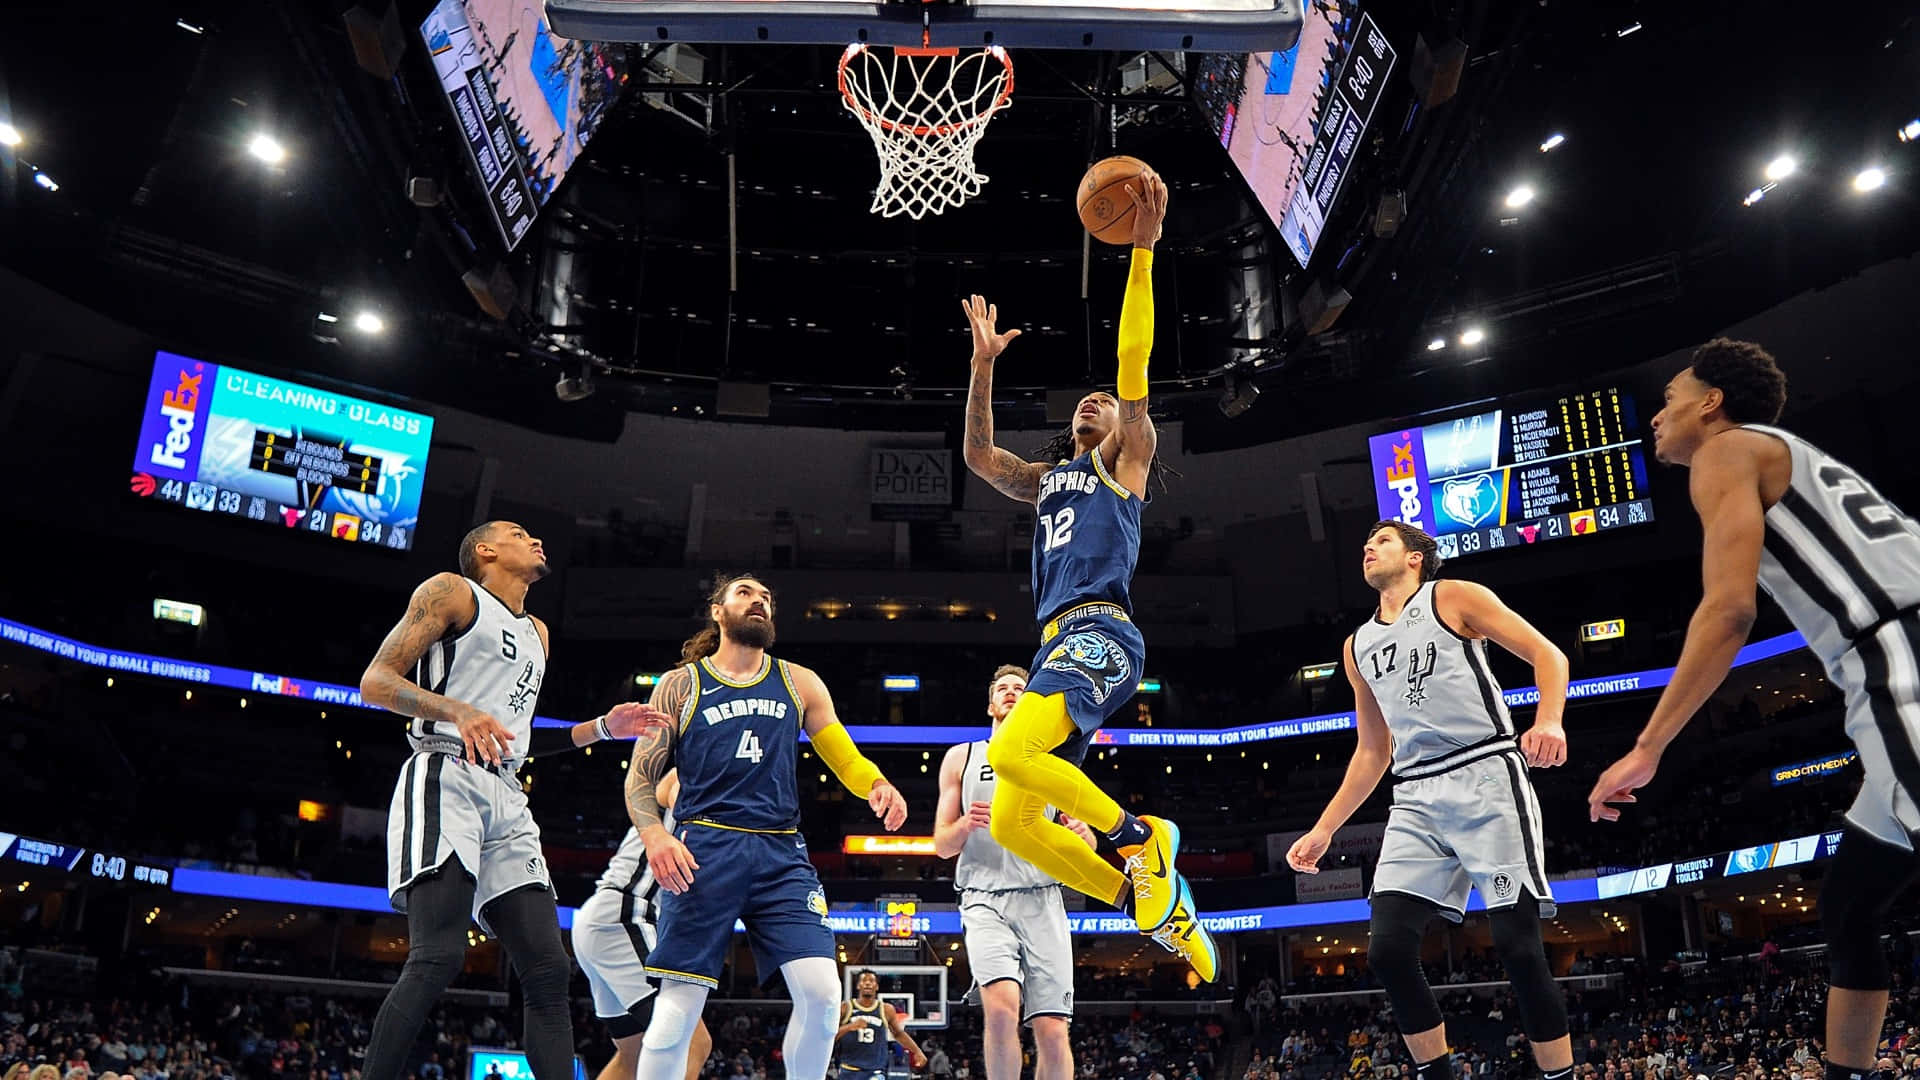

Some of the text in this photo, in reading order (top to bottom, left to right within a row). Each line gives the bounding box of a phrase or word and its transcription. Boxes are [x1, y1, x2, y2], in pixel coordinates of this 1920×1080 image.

[1349, 56, 1373, 100] 8:40
[500, 179, 523, 217] 8:40
[226, 375, 337, 415] CLEANING
[349, 404, 422, 435] GLASS
[151, 369, 203, 469] FedEx
[1519, 410, 1548, 423] JOHNSON
[1519, 419, 1546, 432] MURRAY
[1520, 426, 1560, 441] MCDERMOTT
[1522, 439, 1550, 450] VASSELL
[1524, 449, 1547, 460] POELTL
[1527, 467, 1550, 479] ADAMS
[1528, 475, 1560, 489] WILLIAMS
[875, 476, 948, 493] POIER
[1530, 485, 1557, 498] MORANT
[1532, 495, 1560, 507] JACKSON
[1560, 493, 1570, 502] JR.
[161, 479, 184, 501] 44
[220, 490, 241, 514] 33
[310, 509, 326, 532] 21
[362, 519, 382, 543] 34
[1533, 506, 1550, 518] BANE
[1040, 507, 1075, 552] 12
[1462, 531, 1481, 552] 33
[1548, 518, 1563, 537] 21
[1600, 508, 1620, 528] 34
[3, 623, 27, 643] WIN
[54, 640, 76, 658] FOR
[77, 646, 107, 666] YOUR
[109, 654, 149, 673] SMALL
[151, 661, 211, 682] BUSINESS
[502, 629, 516, 660] 5
[1371, 642, 1397, 680] 17
[251, 671, 300, 697] FedEx
[313, 686, 349, 704] APPLY
[702, 699, 787, 726] MEMPHIS
[1129, 733, 1161, 744] ENTER
[1161, 734, 1174, 744] TO
[1176, 734, 1197, 745] WIN
[1198, 734, 1221, 745] $50K
[1222, 732, 1240, 744] FOR
[1241, 729, 1267, 742] YOUR
[1268, 724, 1300, 738] SMALL
[1302, 717, 1351, 734] BUSINESS
[735, 730, 763, 763] 4
[1776, 769, 1801, 781] GRIND
[1801, 764, 1820, 775] CITY
[1789, 841, 1799, 861] 7
[91, 853, 126, 881] 8:40
[1675, 860, 1707, 873] TIMEOUTS:
[1644, 868, 1657, 889] 12
[1081, 919, 1098, 931] AT
[858, 1028, 874, 1043] 13
